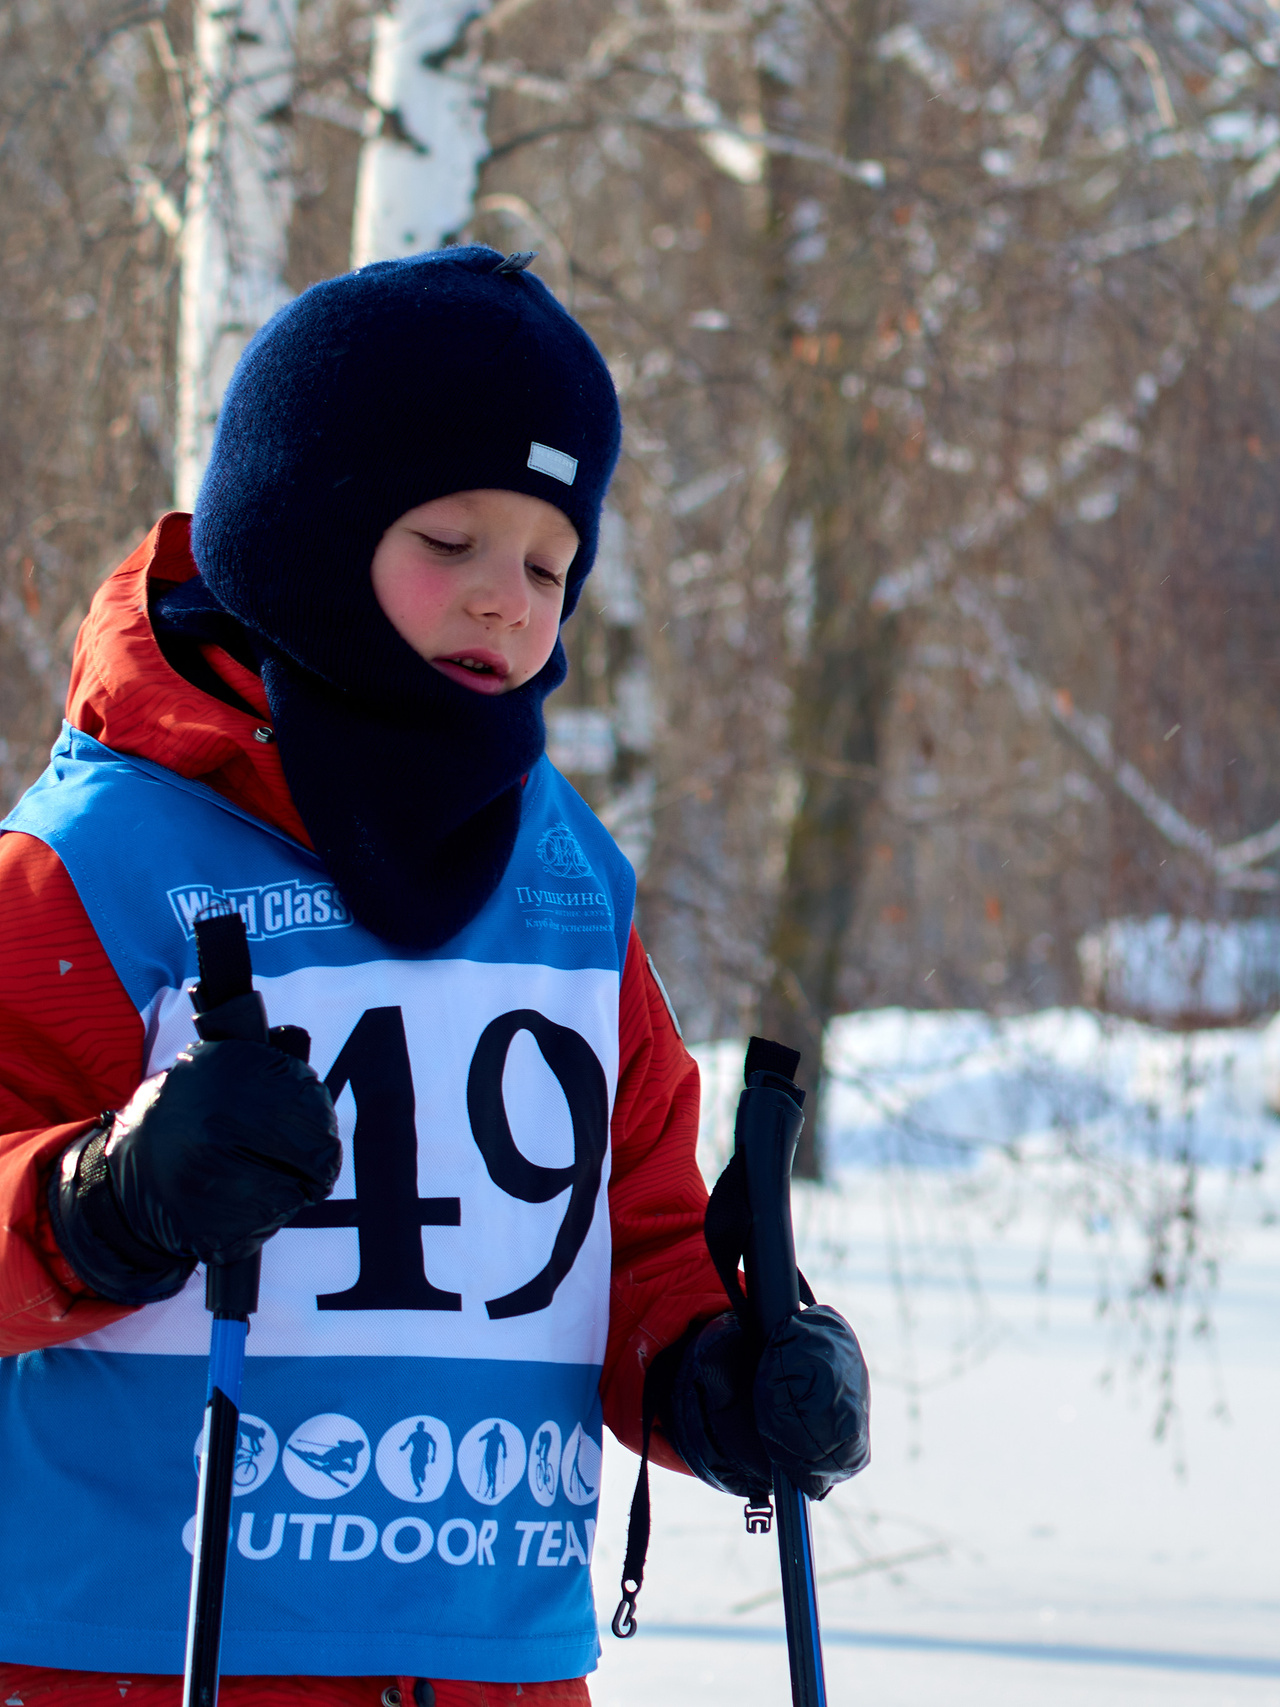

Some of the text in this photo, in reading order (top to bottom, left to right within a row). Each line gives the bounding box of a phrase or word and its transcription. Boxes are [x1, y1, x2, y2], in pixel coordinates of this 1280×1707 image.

[263, 888, 348, 932] Class
[516, 887, 608, 907] Пушкинс
[526, 918, 549, 931] Клуб
[281, 1005, 609, 1320] 49
